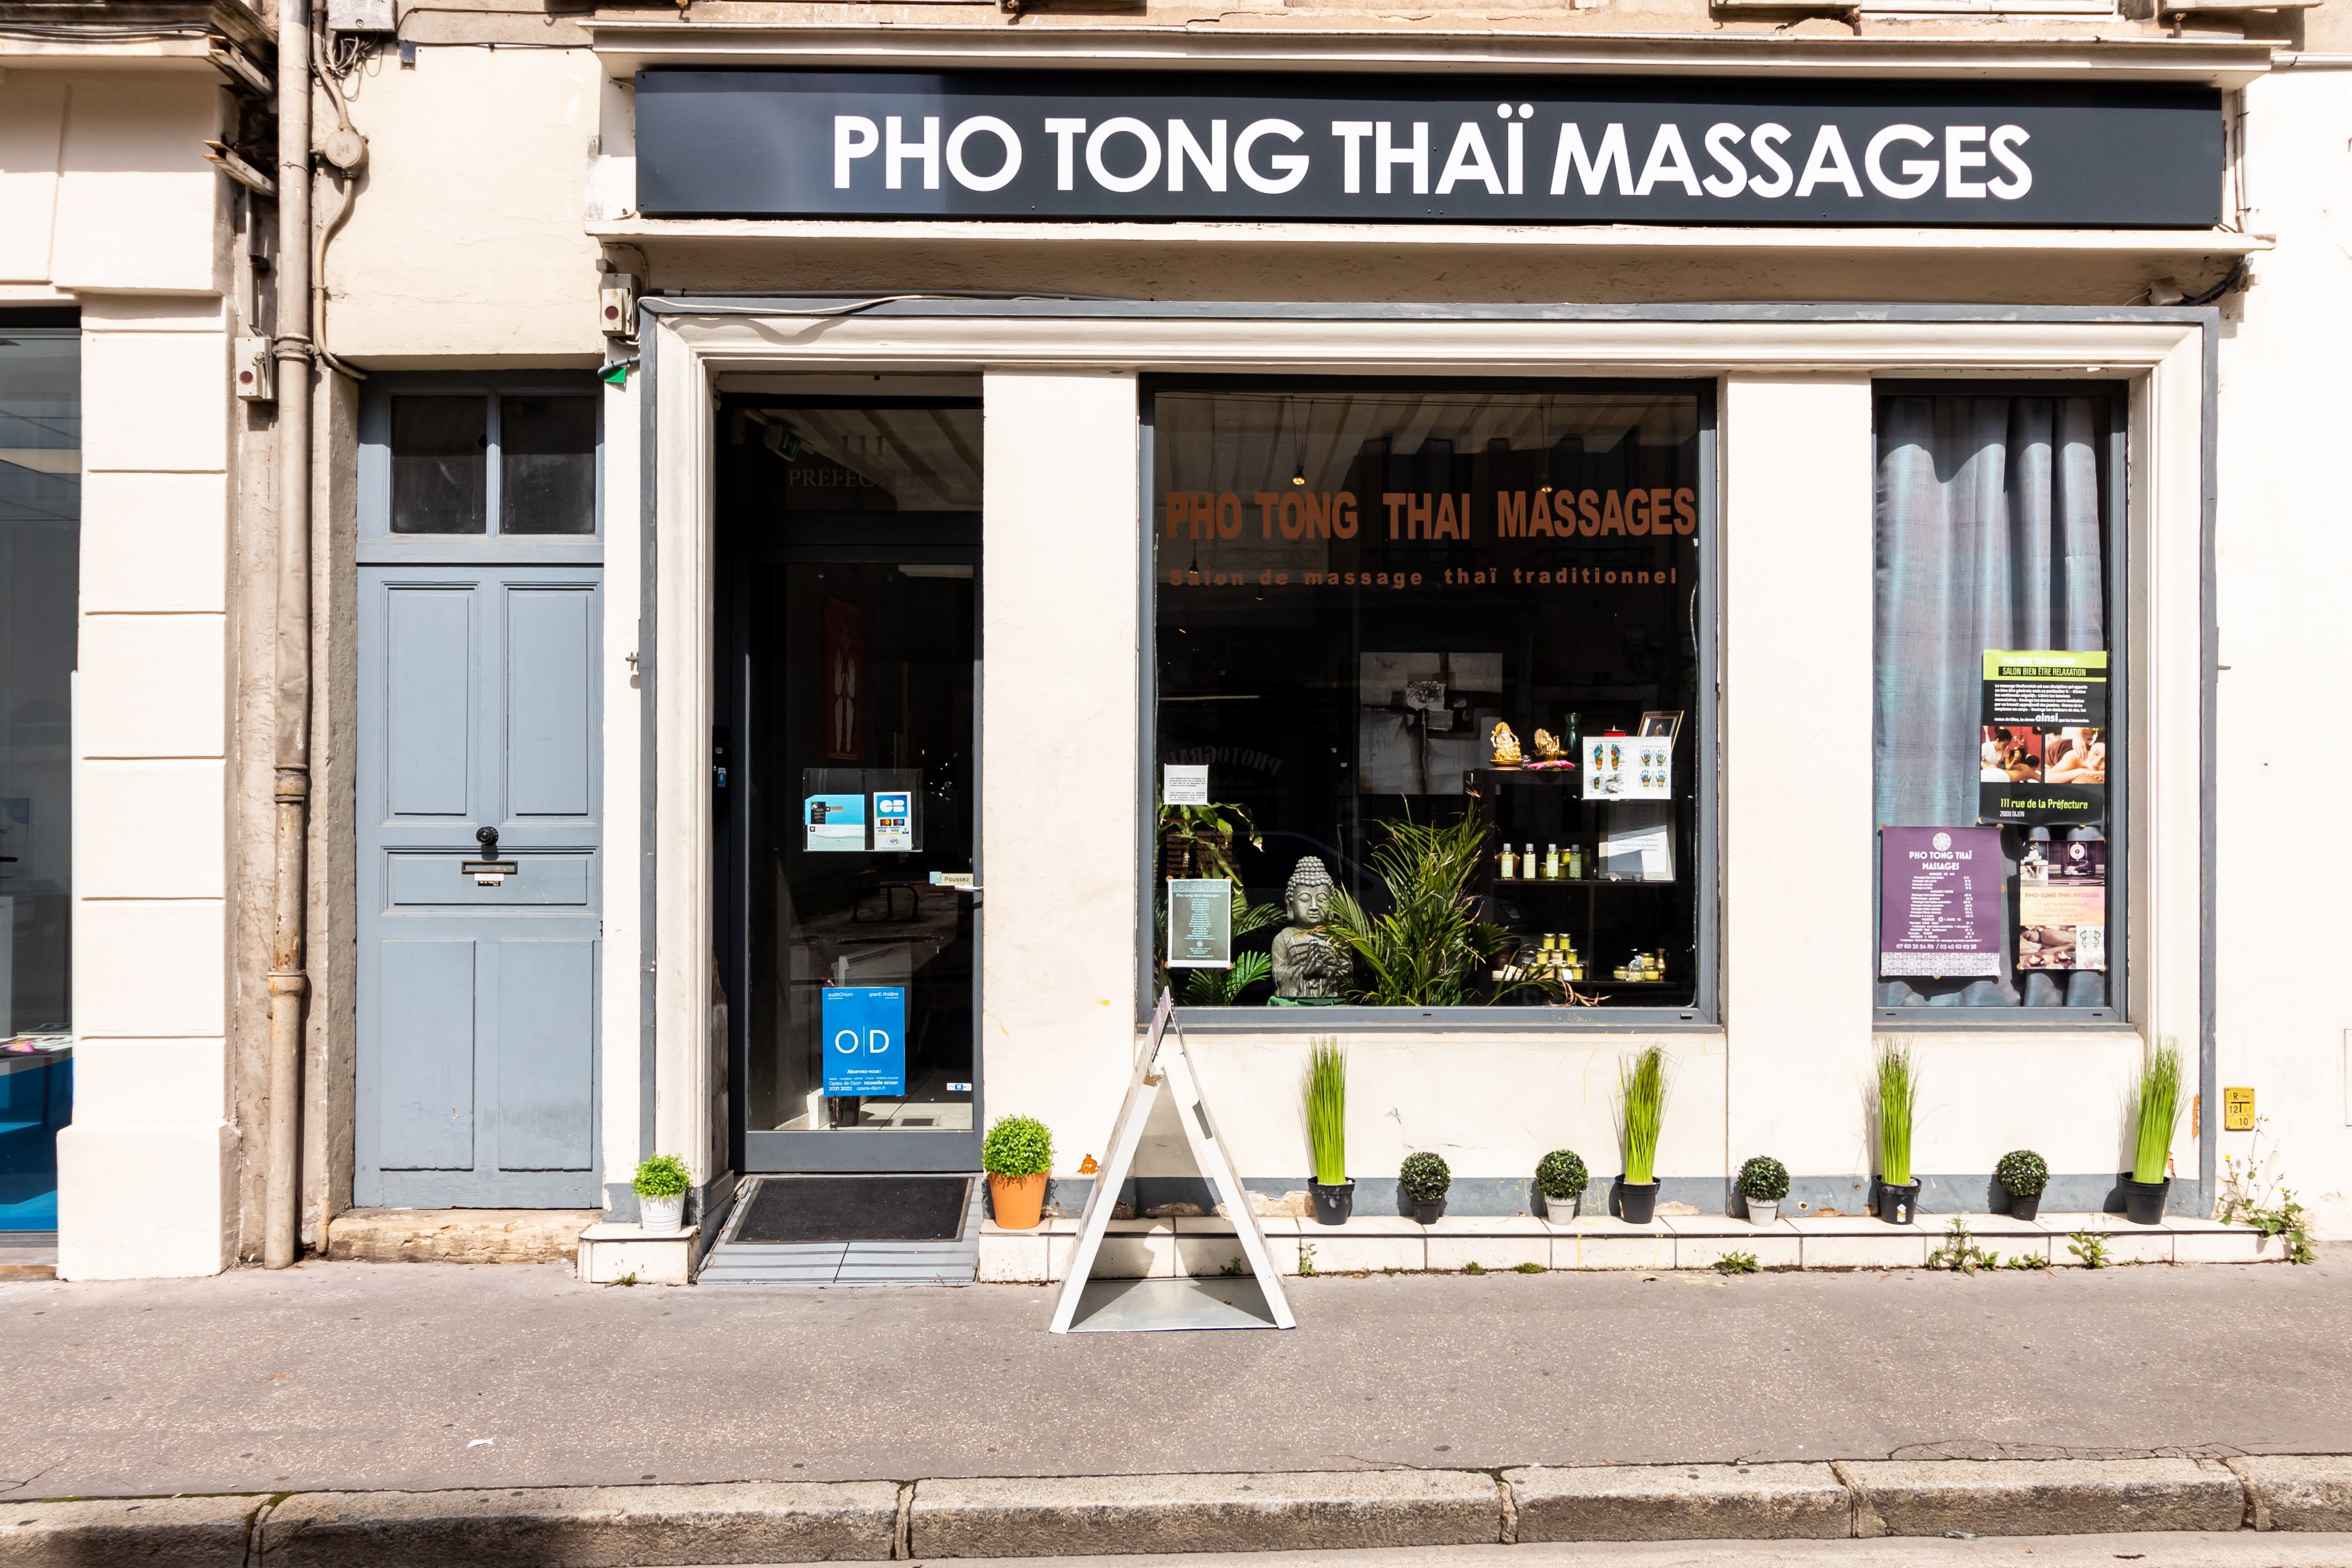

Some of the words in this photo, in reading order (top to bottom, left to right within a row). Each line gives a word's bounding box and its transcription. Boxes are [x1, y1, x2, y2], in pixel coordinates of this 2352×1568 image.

[835, 115, 1022, 191] PHO
[1045, 117, 1309, 194] TONG
[1332, 103, 1534, 195] THAÏ
[1550, 122, 2032, 200] MASSAGES
[1166, 492, 1241, 540] PHO
[1255, 491, 1358, 540] TONG
[1383, 493, 1470, 540] THAI
[1498, 487, 1696, 537] MASSAGES
[1170, 568, 1244, 586] Salon
[1260, 569, 1289, 585] de
[1304, 572, 1422, 589] massage
[1445, 568, 1496, 585] thaï
[1513, 567, 1676, 584] traditionnel
[2002, 667, 2021, 676] SALON
[2023, 667, 2037, 676] BIEN
[2038, 666, 2052, 676] ÊTRE
[2053, 668, 2086, 676] RELAXATION
[2035, 712, 2059, 722] ainsi
[879, 799, 905, 813] CB
[2001, 798, 2010, 808] 111
[2027, 799, 2037, 808] de
[2038, 799, 2046, 808] la
[2048, 799, 2088, 810] Préfecture
[1909, 851, 1928, 859] PHO
[1929, 851, 1954, 859] TONG
[1955, 850, 1972, 859] THAÏ
[1922, 862, 1960, 871] MASSAGES
[835, 1030, 859, 1054] O
[869, 1030, 890, 1054] D
[2239, 1117, 2248, 1126] 10
